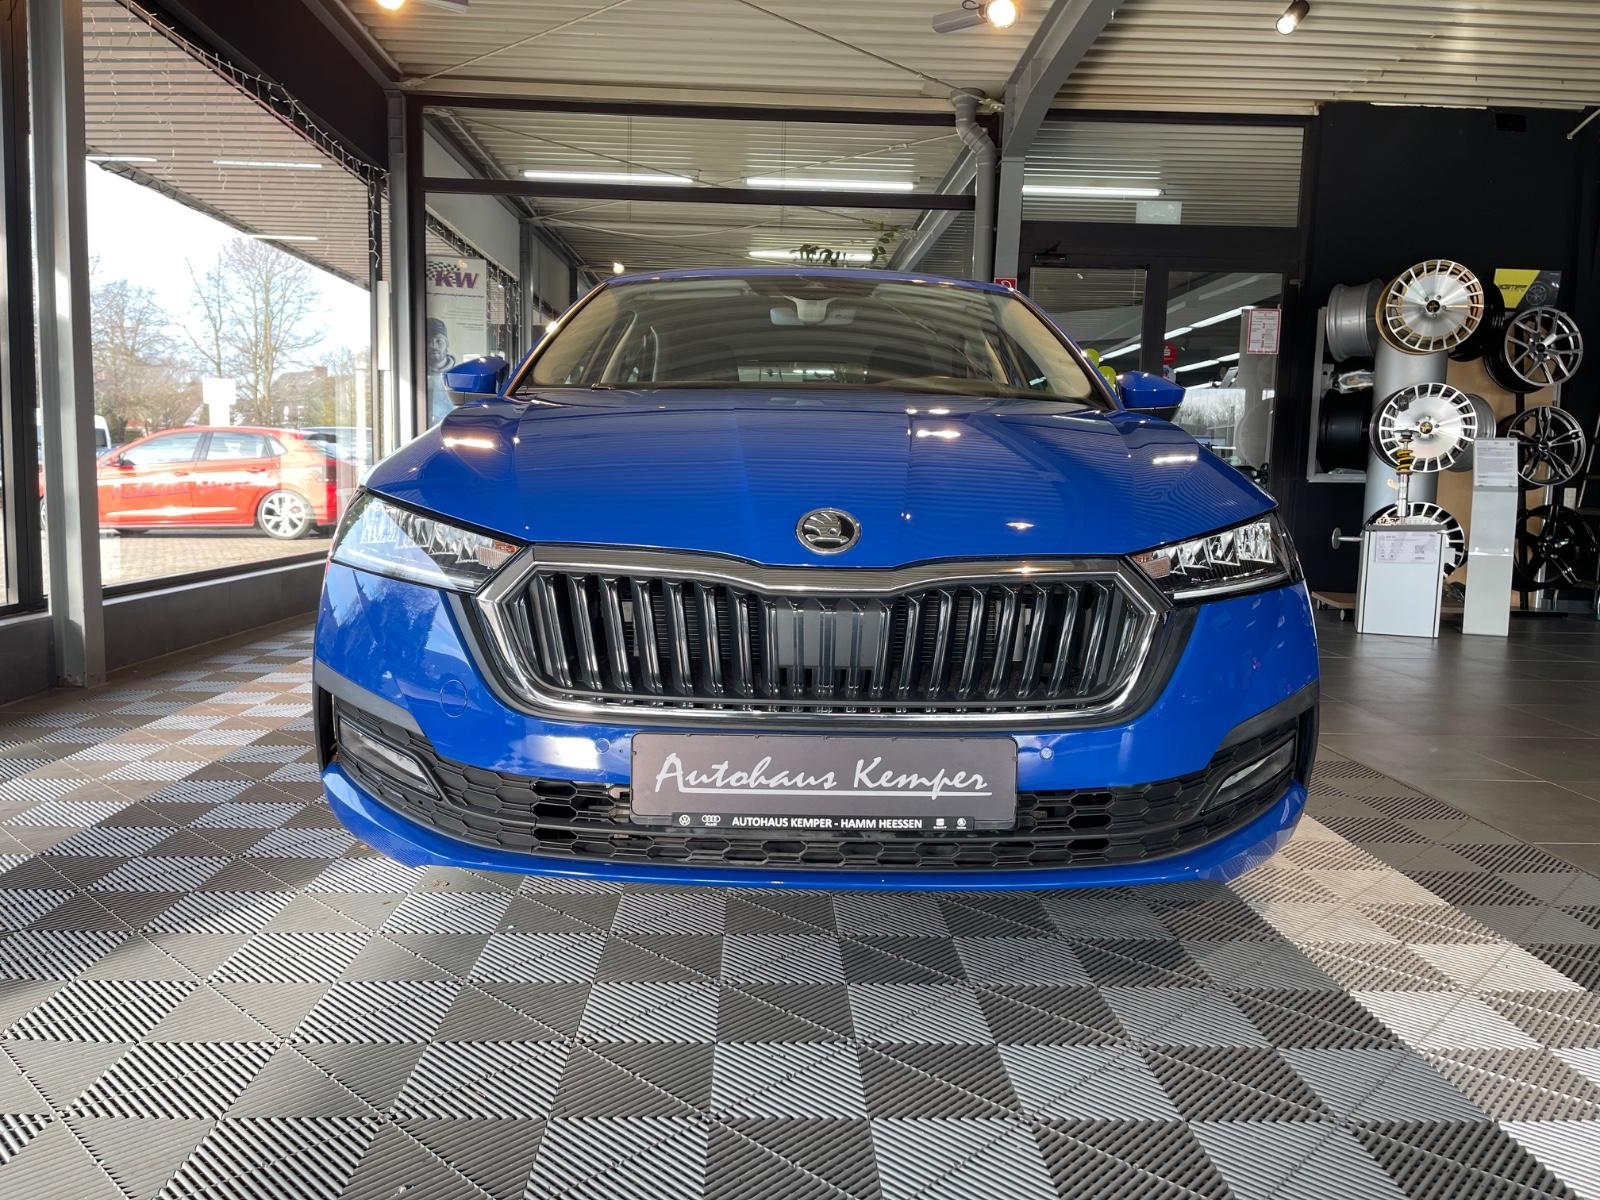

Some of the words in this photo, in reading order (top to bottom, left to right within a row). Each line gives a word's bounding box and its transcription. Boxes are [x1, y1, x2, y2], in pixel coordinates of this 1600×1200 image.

[435, 270, 478, 288] KW
[655, 752, 837, 794] Autohaus
[853, 756, 988, 800] Kemper
[731, 816, 788, 827] AUTOHAUS
[790, 817, 833, 828] KEMPER
[840, 818, 877, 828] HAMM
[878, 818, 922, 829] HEESSEN
